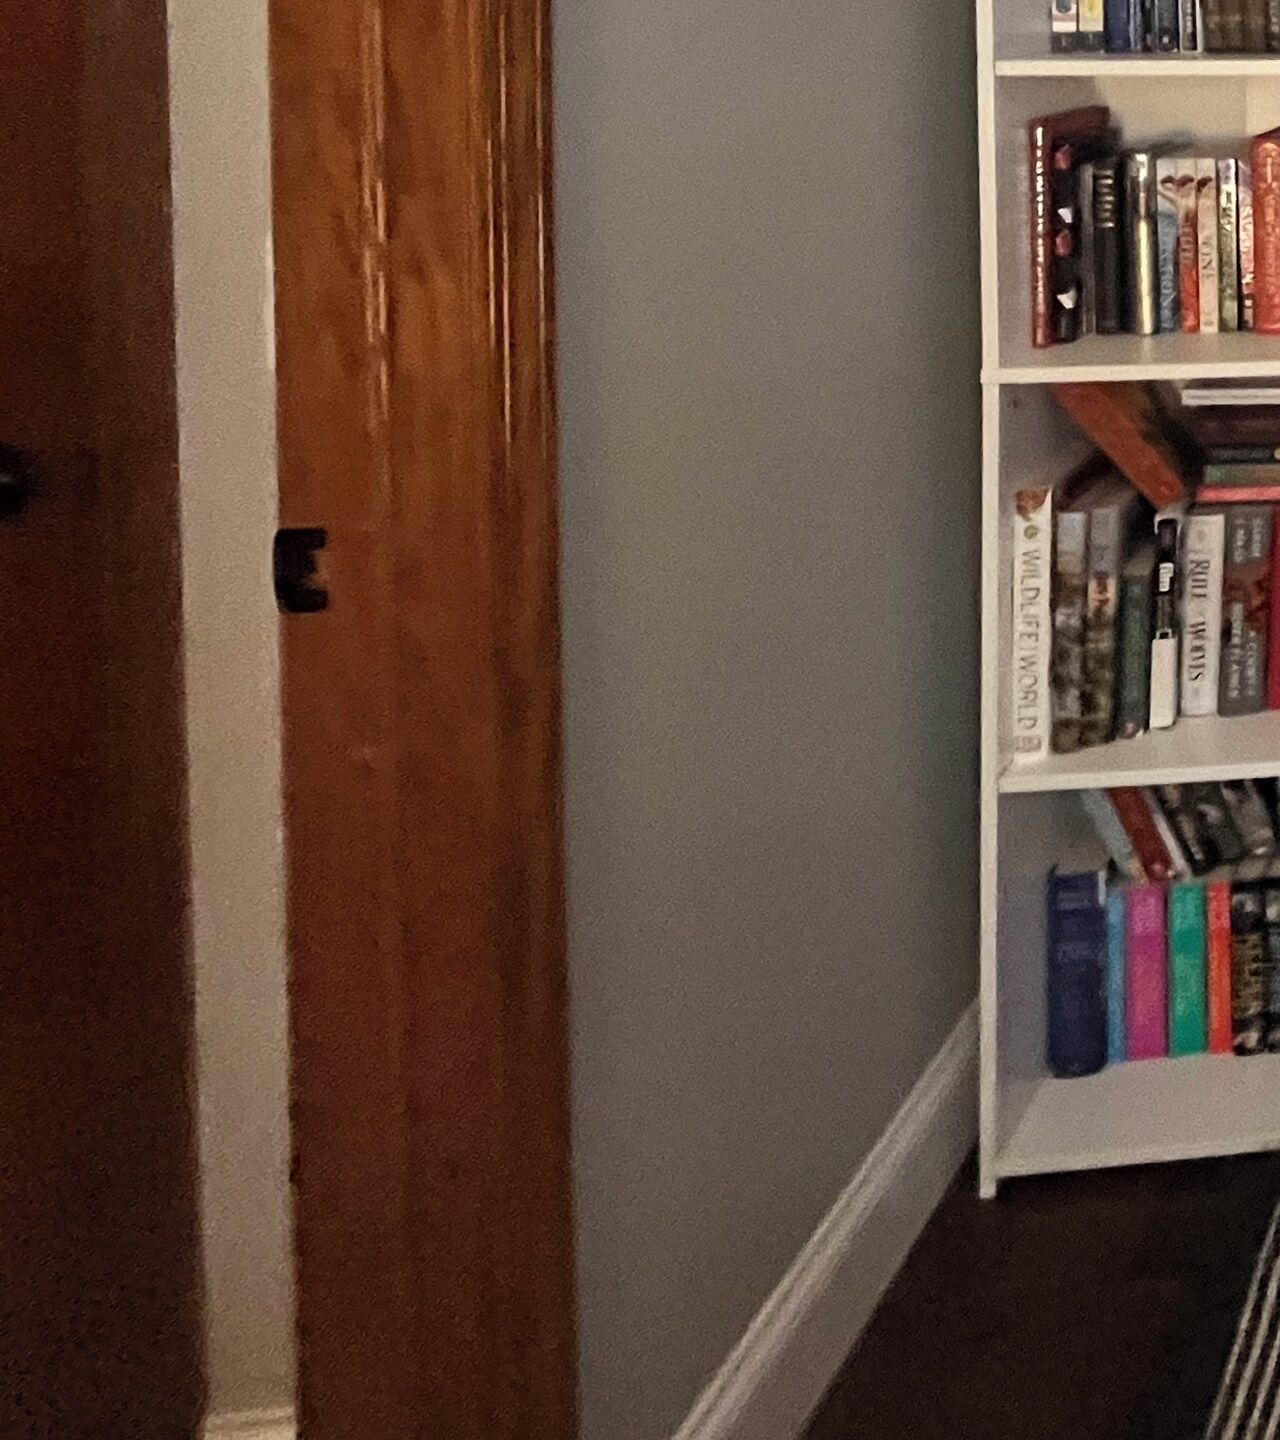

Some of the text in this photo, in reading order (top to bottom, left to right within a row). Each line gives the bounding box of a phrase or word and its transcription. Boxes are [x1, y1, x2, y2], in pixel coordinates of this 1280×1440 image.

[1190, 559, 1210, 600] RULE
[1017, 548, 1041, 730] WILDLIFE WORLD
